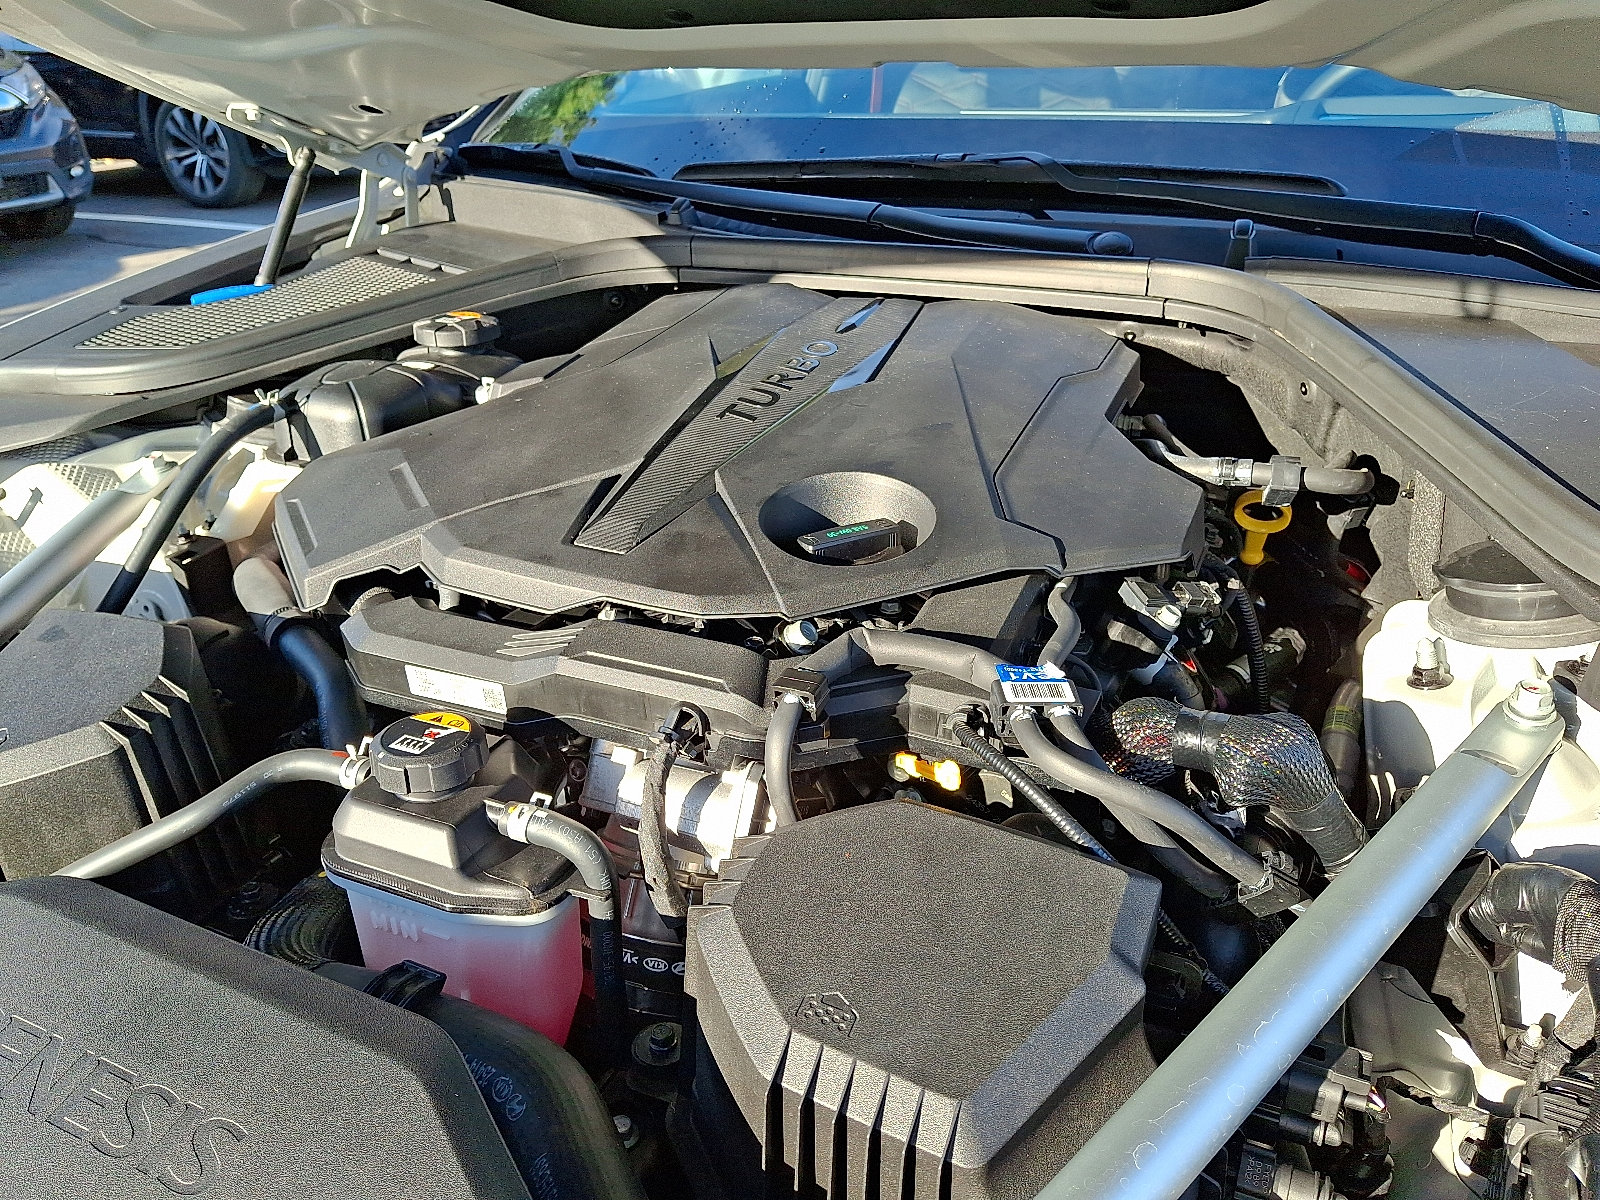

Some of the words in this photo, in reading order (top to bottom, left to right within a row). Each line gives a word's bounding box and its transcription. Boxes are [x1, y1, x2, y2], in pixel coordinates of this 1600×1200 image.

[716, 341, 838, 422] TURBO
[646, 959, 666, 970] KIA
[0, 1006, 249, 1196] ENESIS
